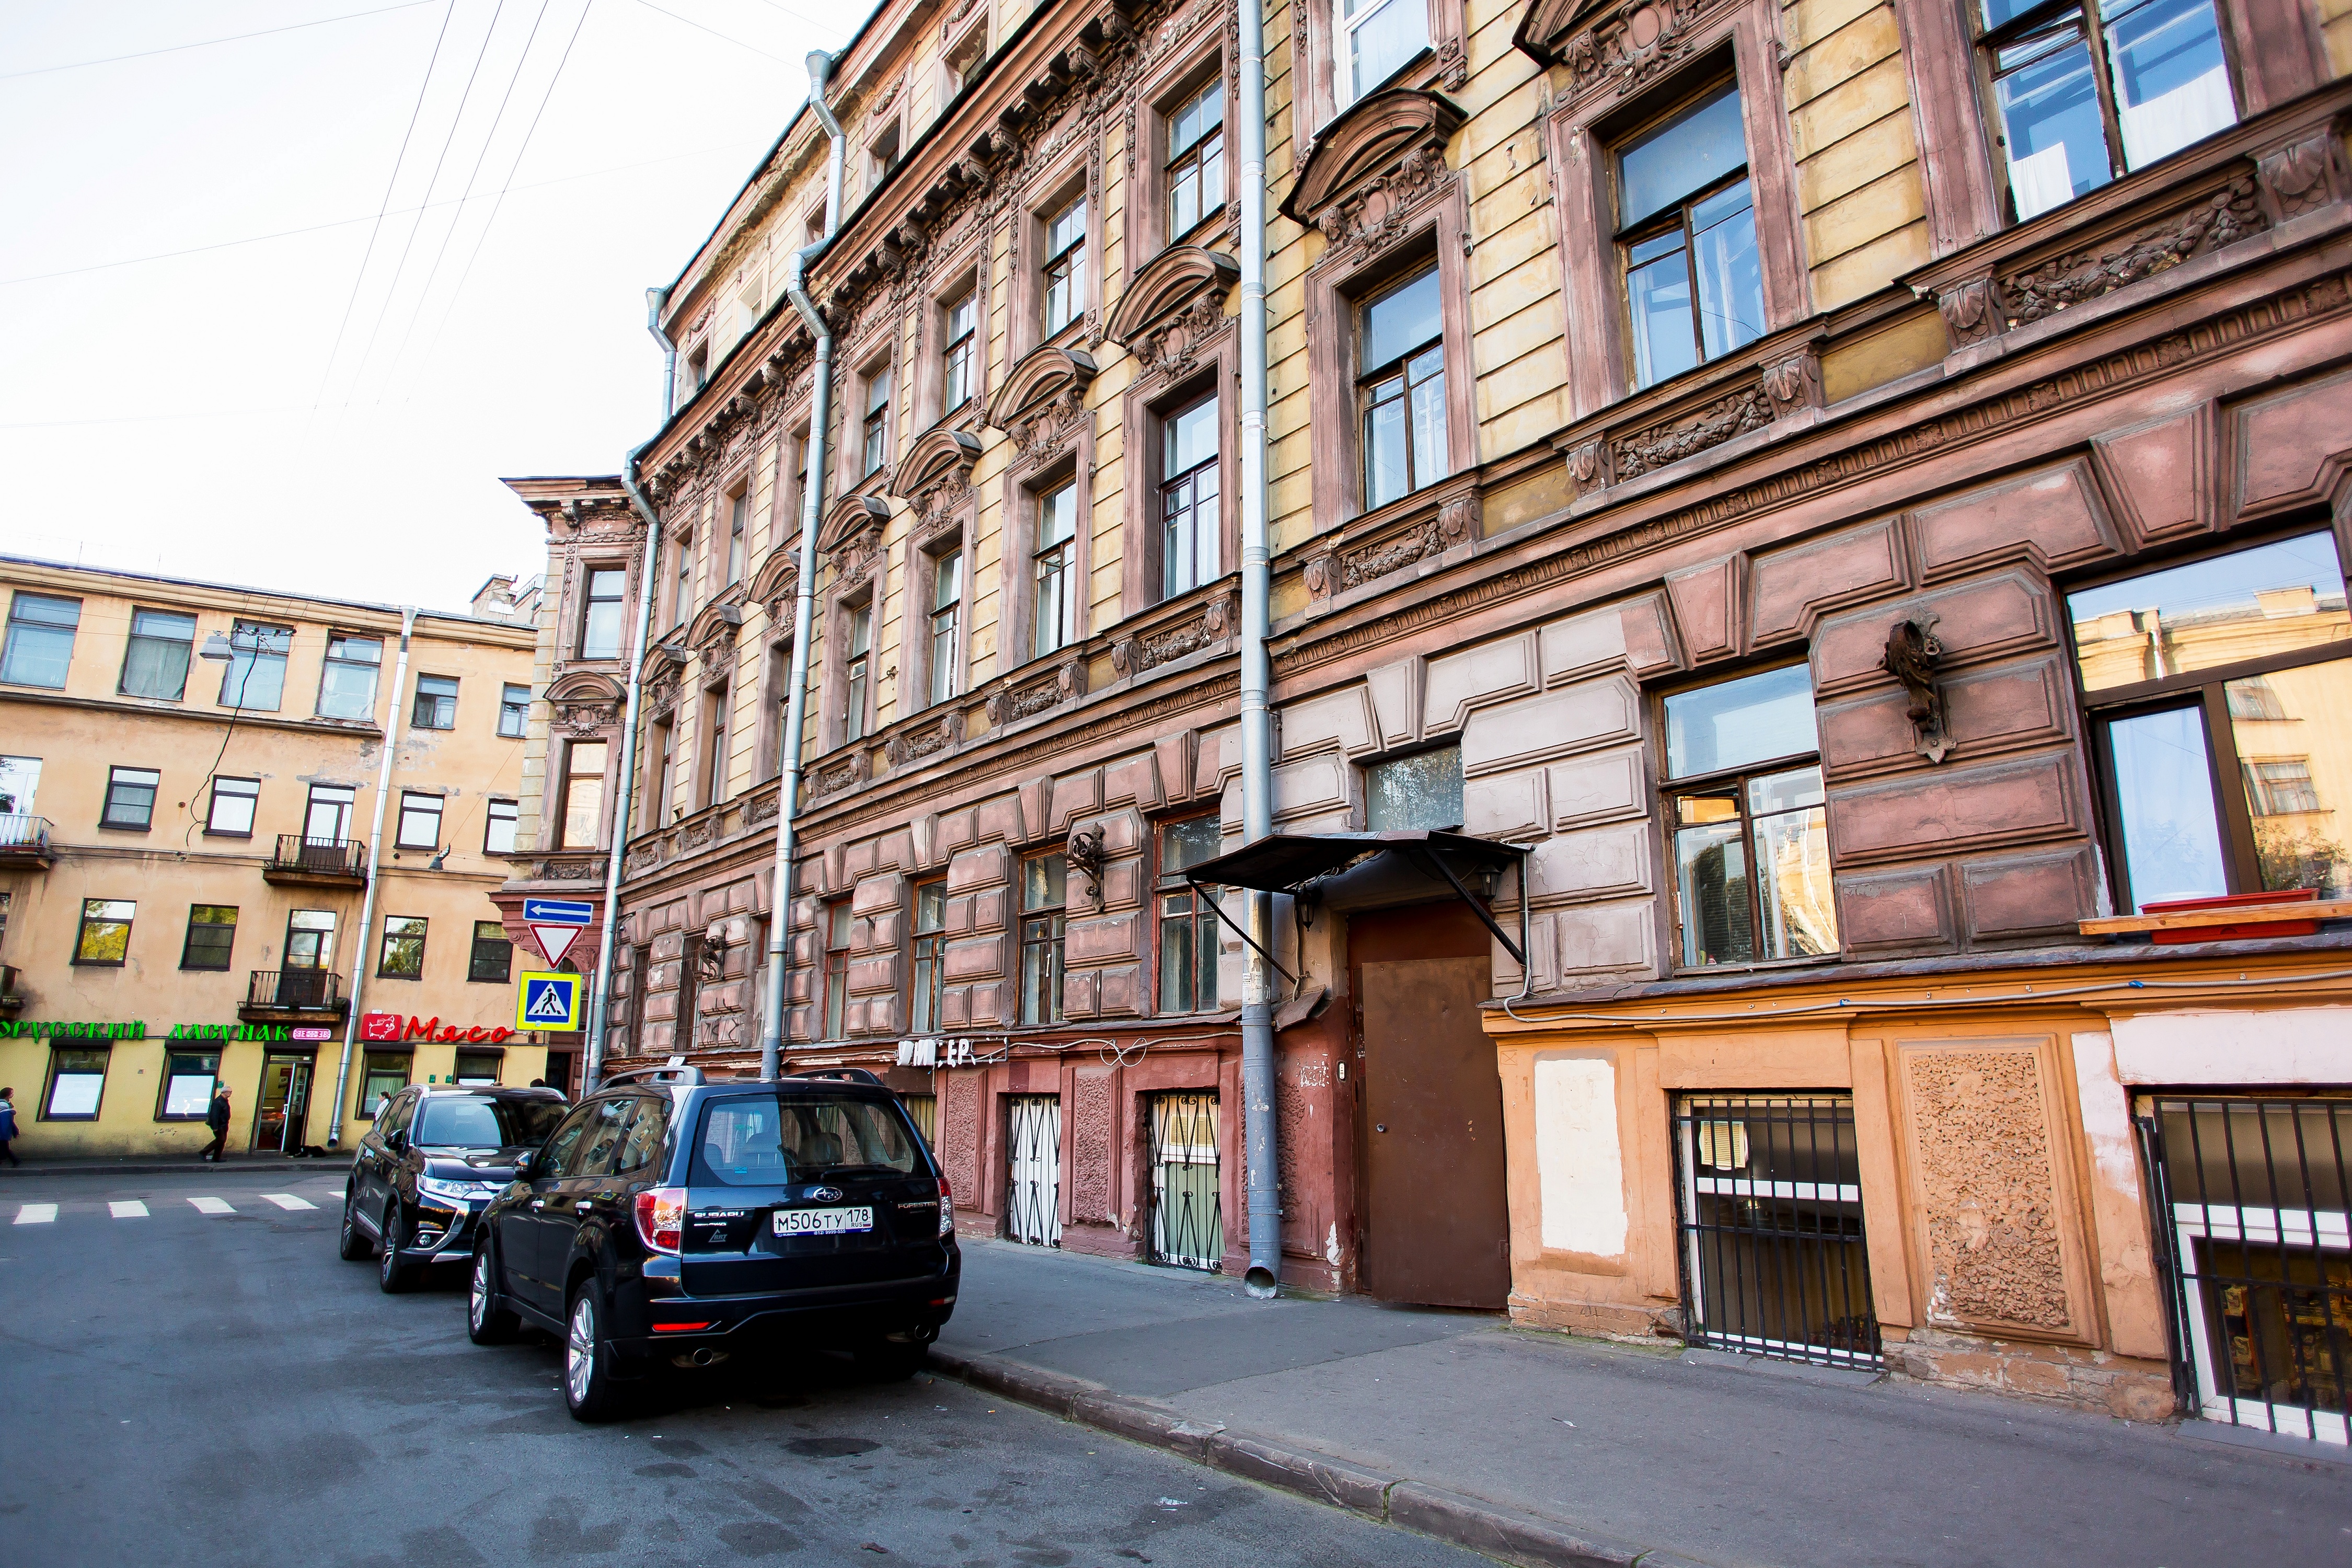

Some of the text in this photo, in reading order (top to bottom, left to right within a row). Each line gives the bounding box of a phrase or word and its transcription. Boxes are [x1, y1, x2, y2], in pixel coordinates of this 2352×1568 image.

[169, 1023, 290, 1046] ЛАСУНАК
[403, 1015, 515, 1043] Мясо
[847, 1208, 869, 1223] 178
